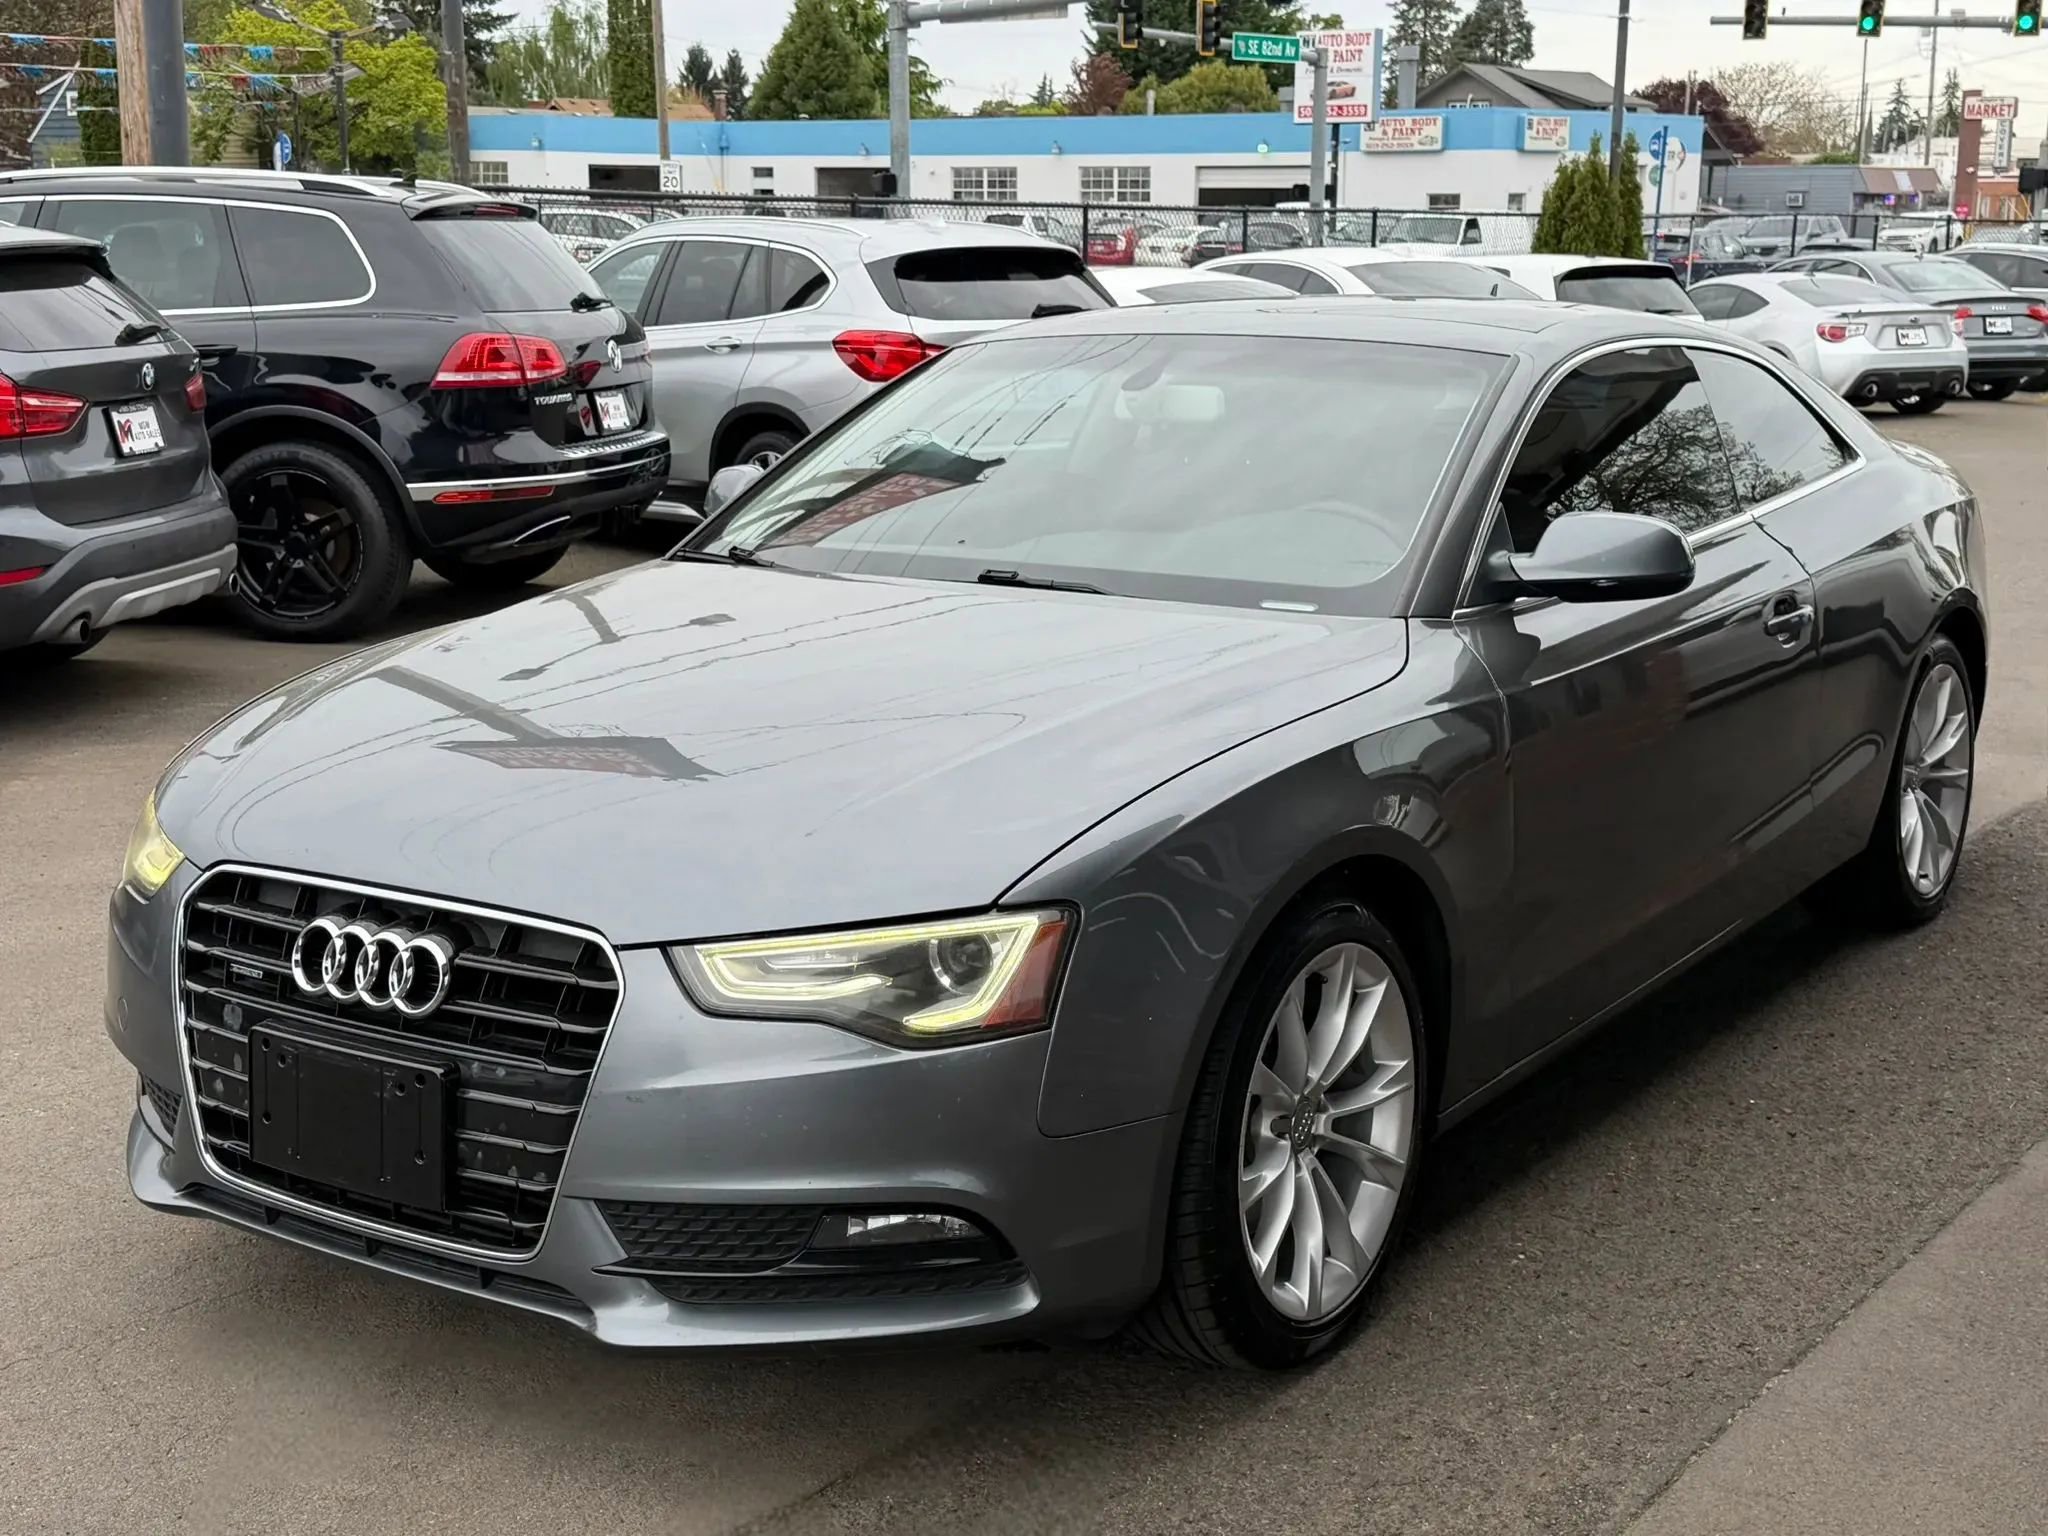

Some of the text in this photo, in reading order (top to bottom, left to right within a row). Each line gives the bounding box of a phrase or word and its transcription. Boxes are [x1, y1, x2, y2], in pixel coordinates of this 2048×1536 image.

[1317, 33, 1343, 47] AUTO
[1345, 32, 1372, 46] BODY
[1247, 39, 1260, 55] SE
[1262, 39, 1282, 56] 82nd
[1284, 41, 1296, 57] Av
[1333, 49, 1363, 63] PAINT
[1966, 104, 2013, 117] MARKET
[1380, 119, 1406, 128] AUTO
[1411, 117, 1439, 127] BODY
[1392, 127, 1424, 137] PAINT
[663, 176, 679, 188] 20
